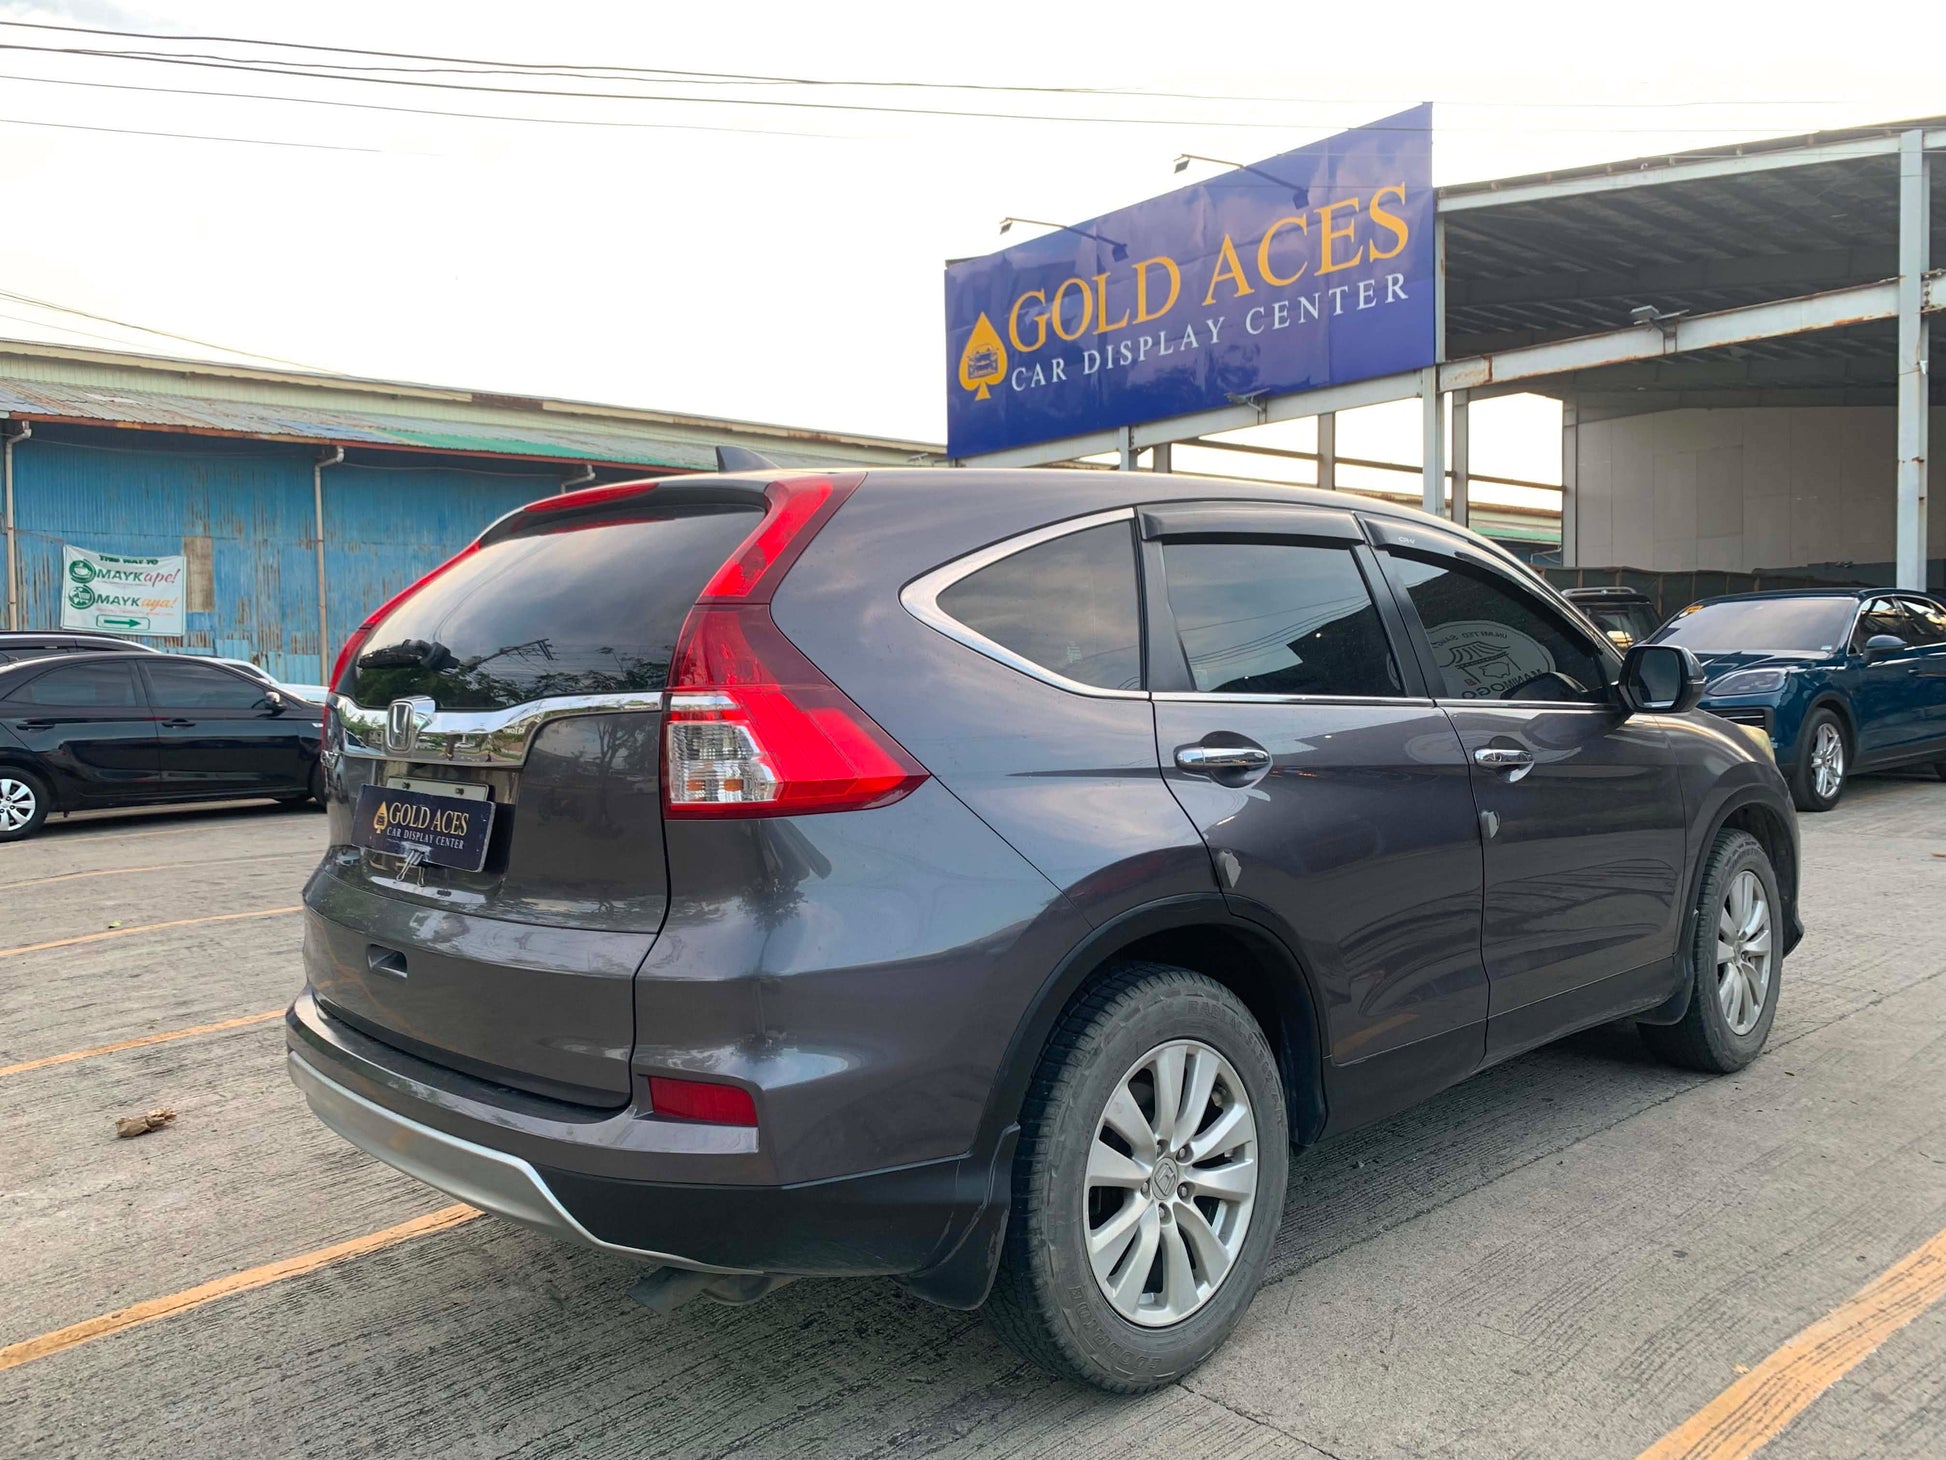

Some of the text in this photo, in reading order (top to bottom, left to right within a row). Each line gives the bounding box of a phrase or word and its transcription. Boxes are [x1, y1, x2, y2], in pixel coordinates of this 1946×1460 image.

[1007, 181, 1410, 353] GOLD ACES
[1011, 272, 1409, 392] CAR DISPLAY CENTER
[386, 826, 465, 850] CAR DISPLAY CENTER
[388, 802, 469, 836] GOLD ACES
